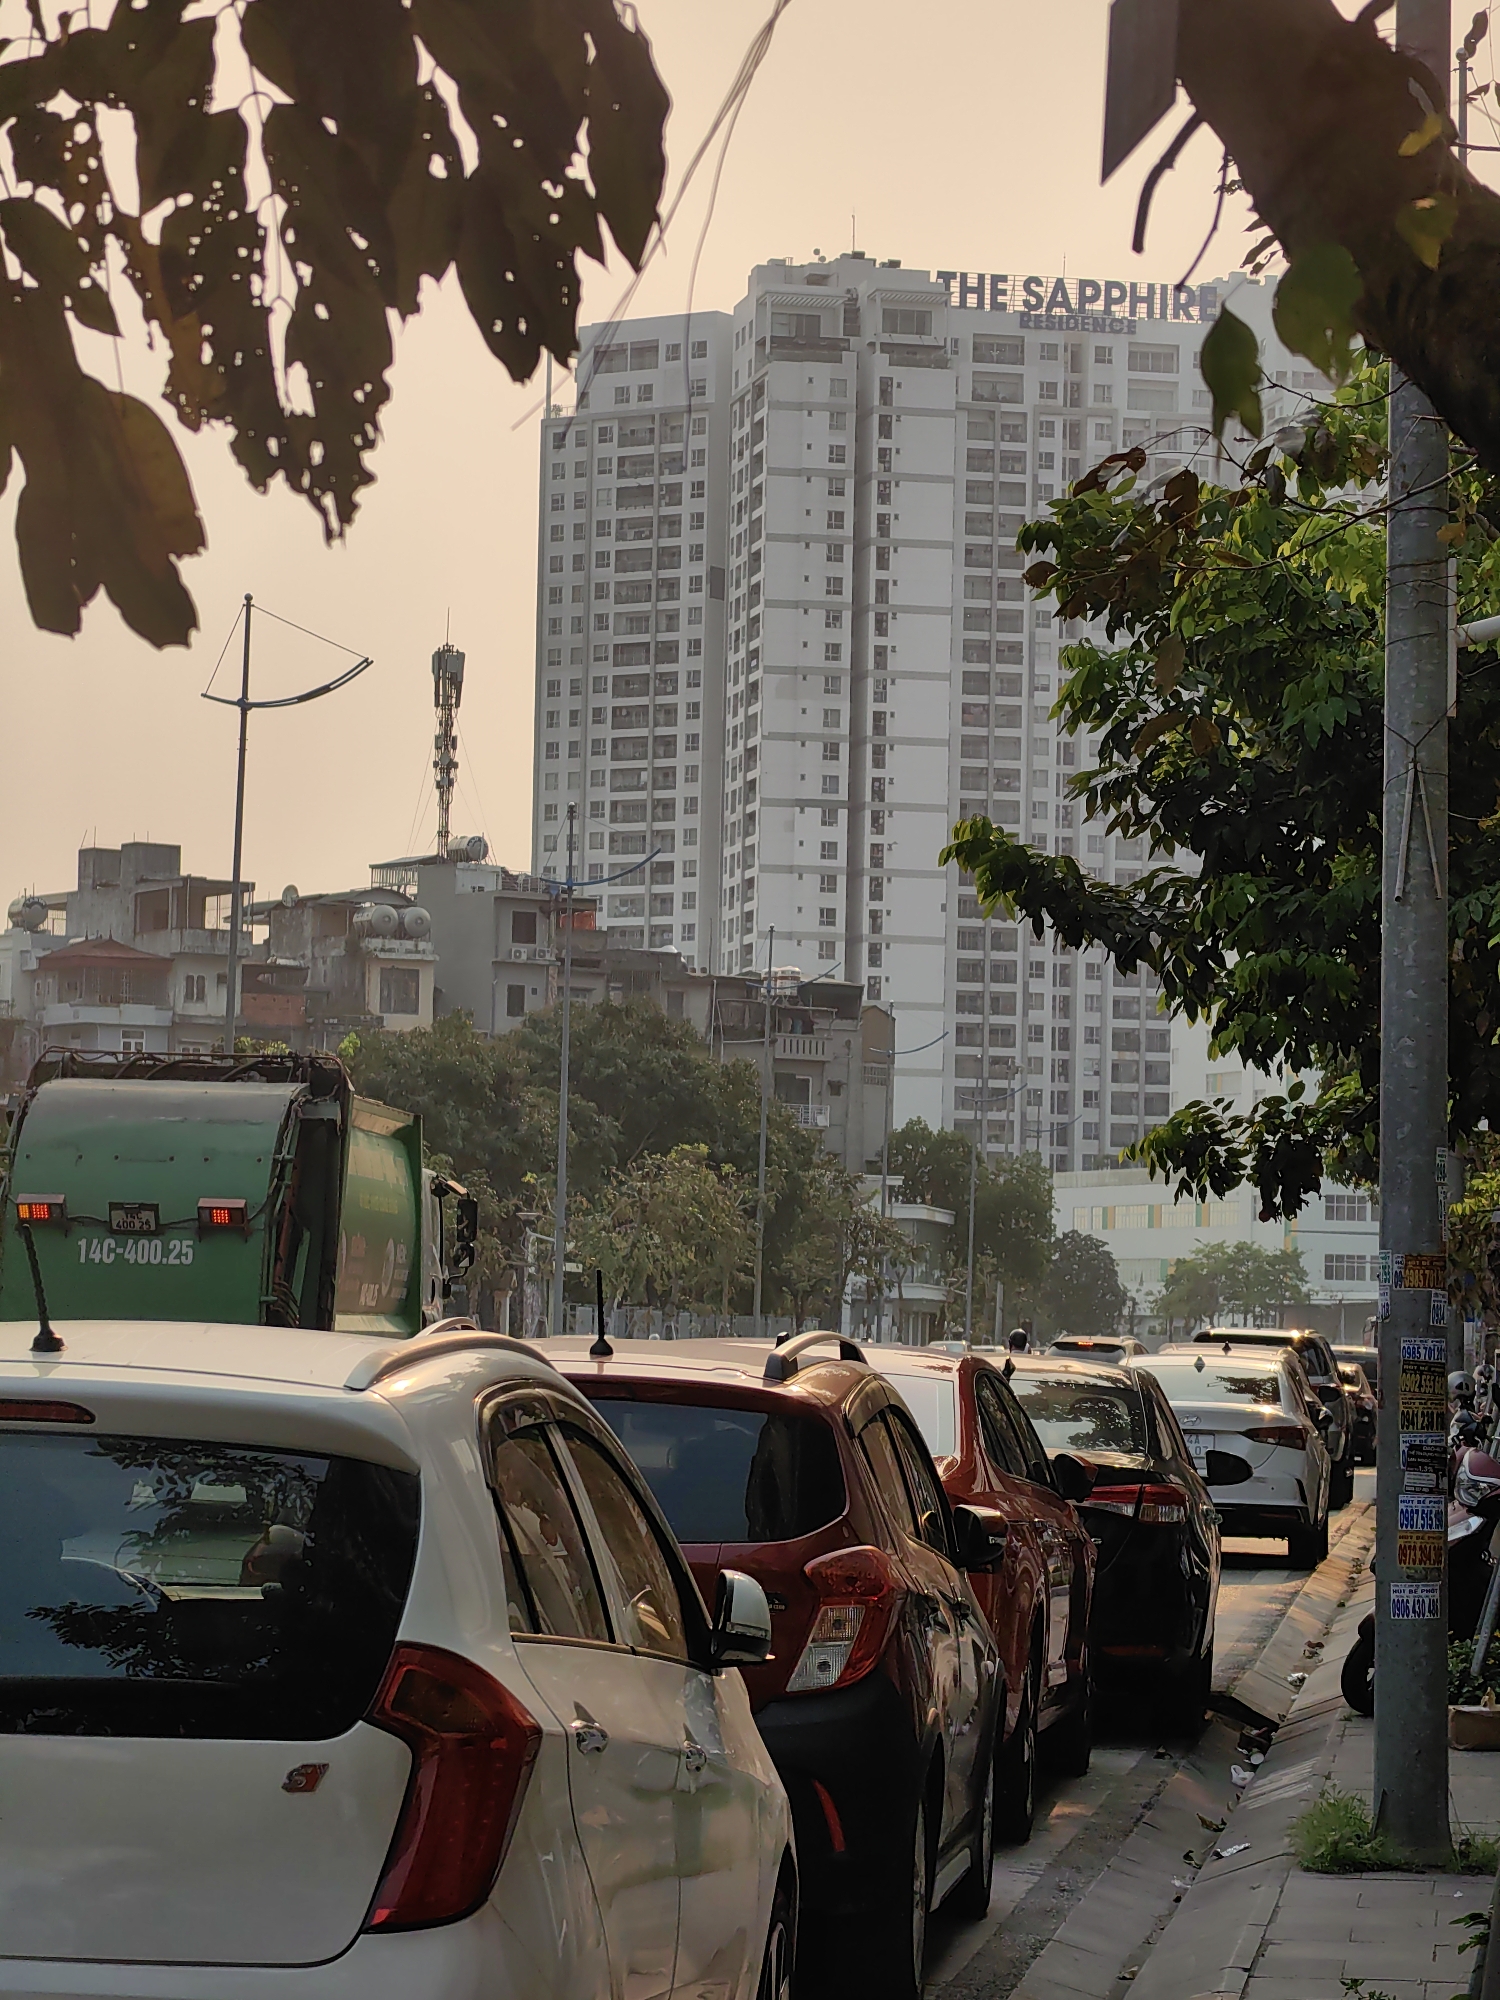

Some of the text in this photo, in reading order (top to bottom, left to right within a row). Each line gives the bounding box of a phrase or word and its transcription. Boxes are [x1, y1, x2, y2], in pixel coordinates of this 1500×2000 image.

[936, 271, 1218, 322] THE SAPPHIRE
[1019, 312, 1137, 335] RESIDENCE
[77, 1237, 194, 1265] 14C-400.25
